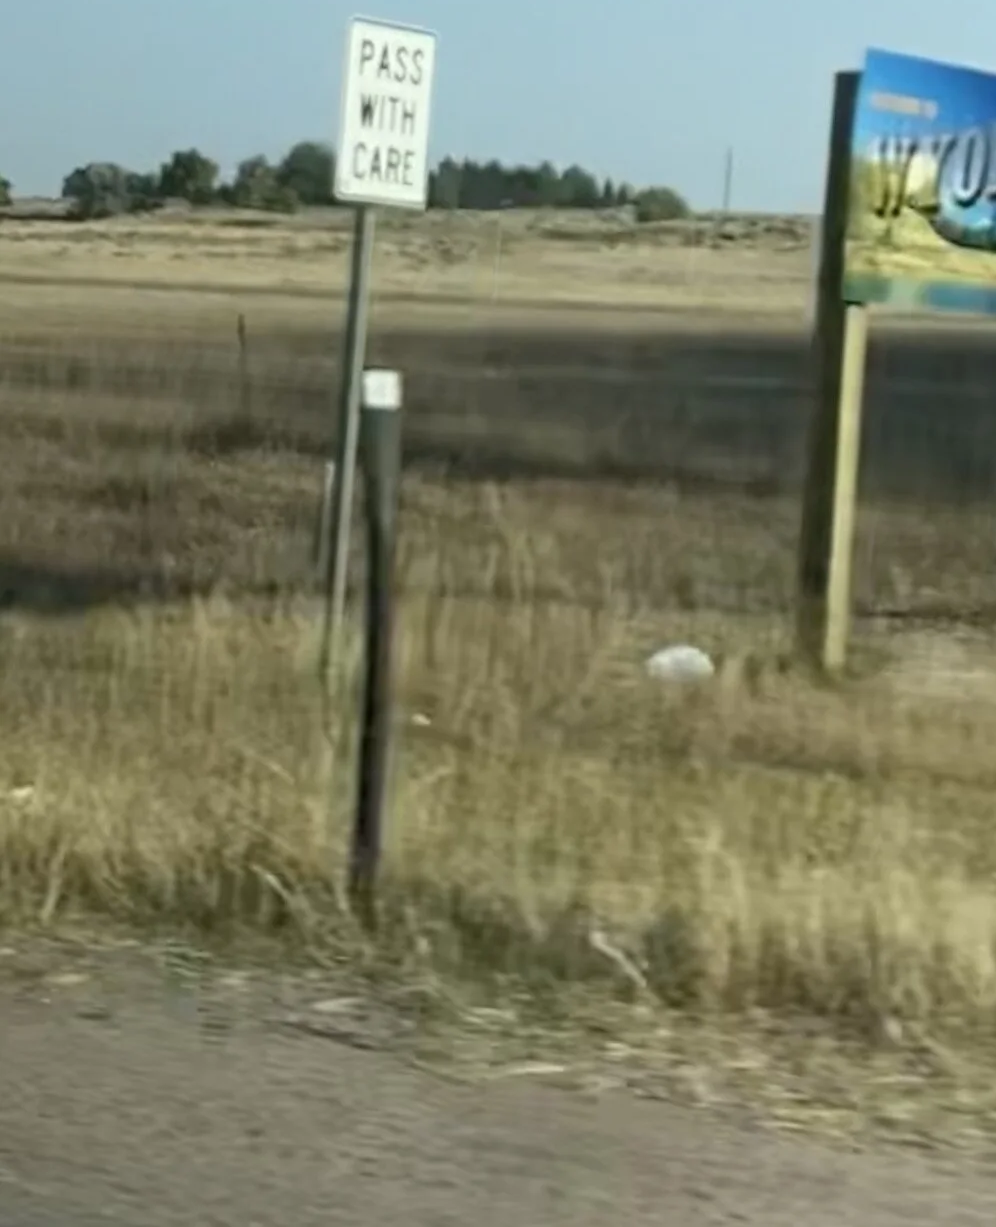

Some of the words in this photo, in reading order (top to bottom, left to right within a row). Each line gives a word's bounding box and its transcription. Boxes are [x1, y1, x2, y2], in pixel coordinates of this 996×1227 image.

[359, 38, 424, 85] PASS
[360, 94, 416, 136] WITH
[352, 141, 415, 186] CARE
